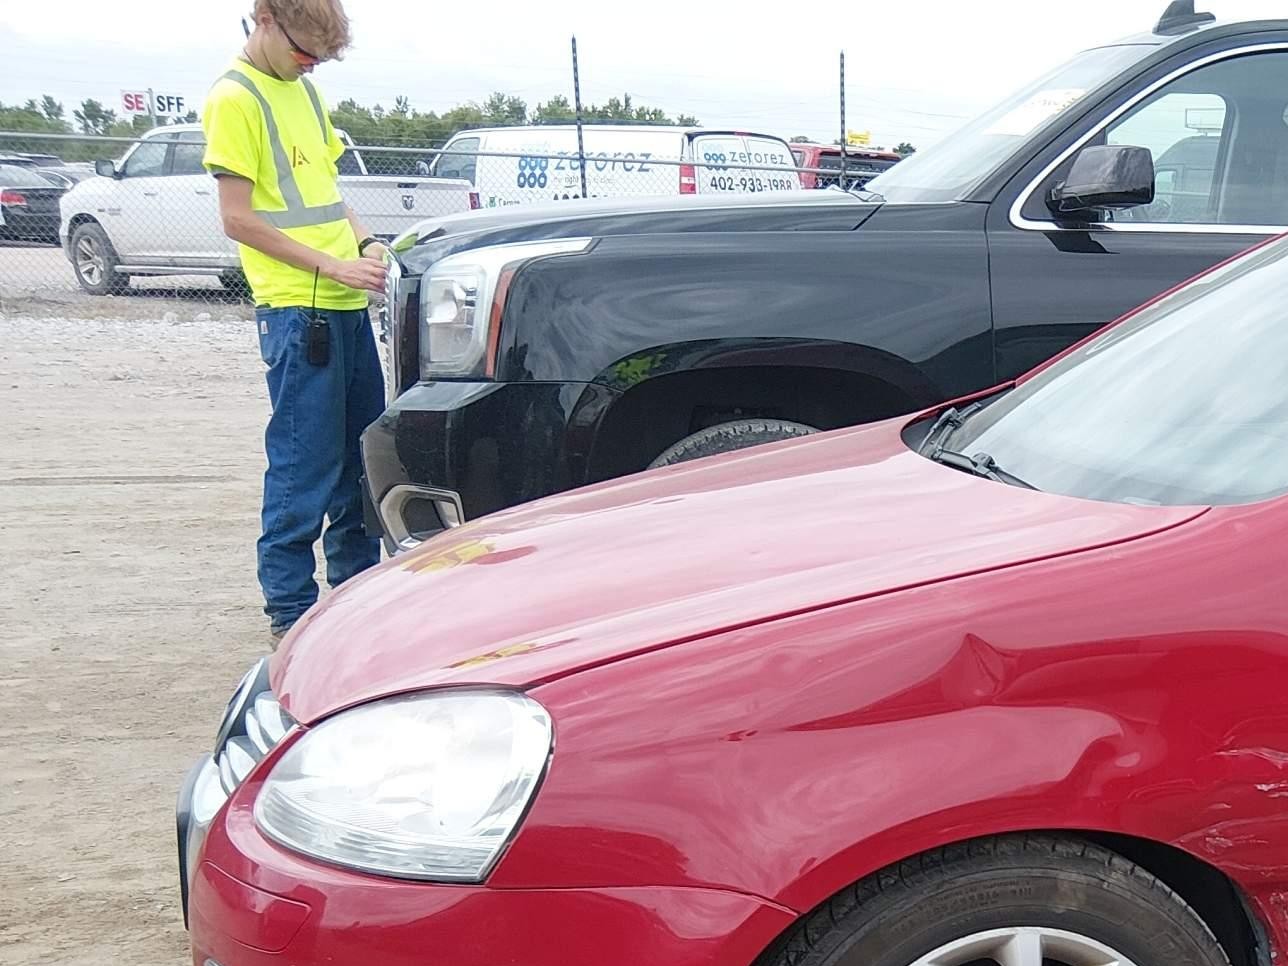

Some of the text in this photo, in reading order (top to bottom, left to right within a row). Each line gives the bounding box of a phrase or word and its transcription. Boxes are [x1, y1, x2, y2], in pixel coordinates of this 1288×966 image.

[124, 93, 145, 111] SE
[156, 95, 185, 112] SFF
[729, 151, 788, 165] zerorez
